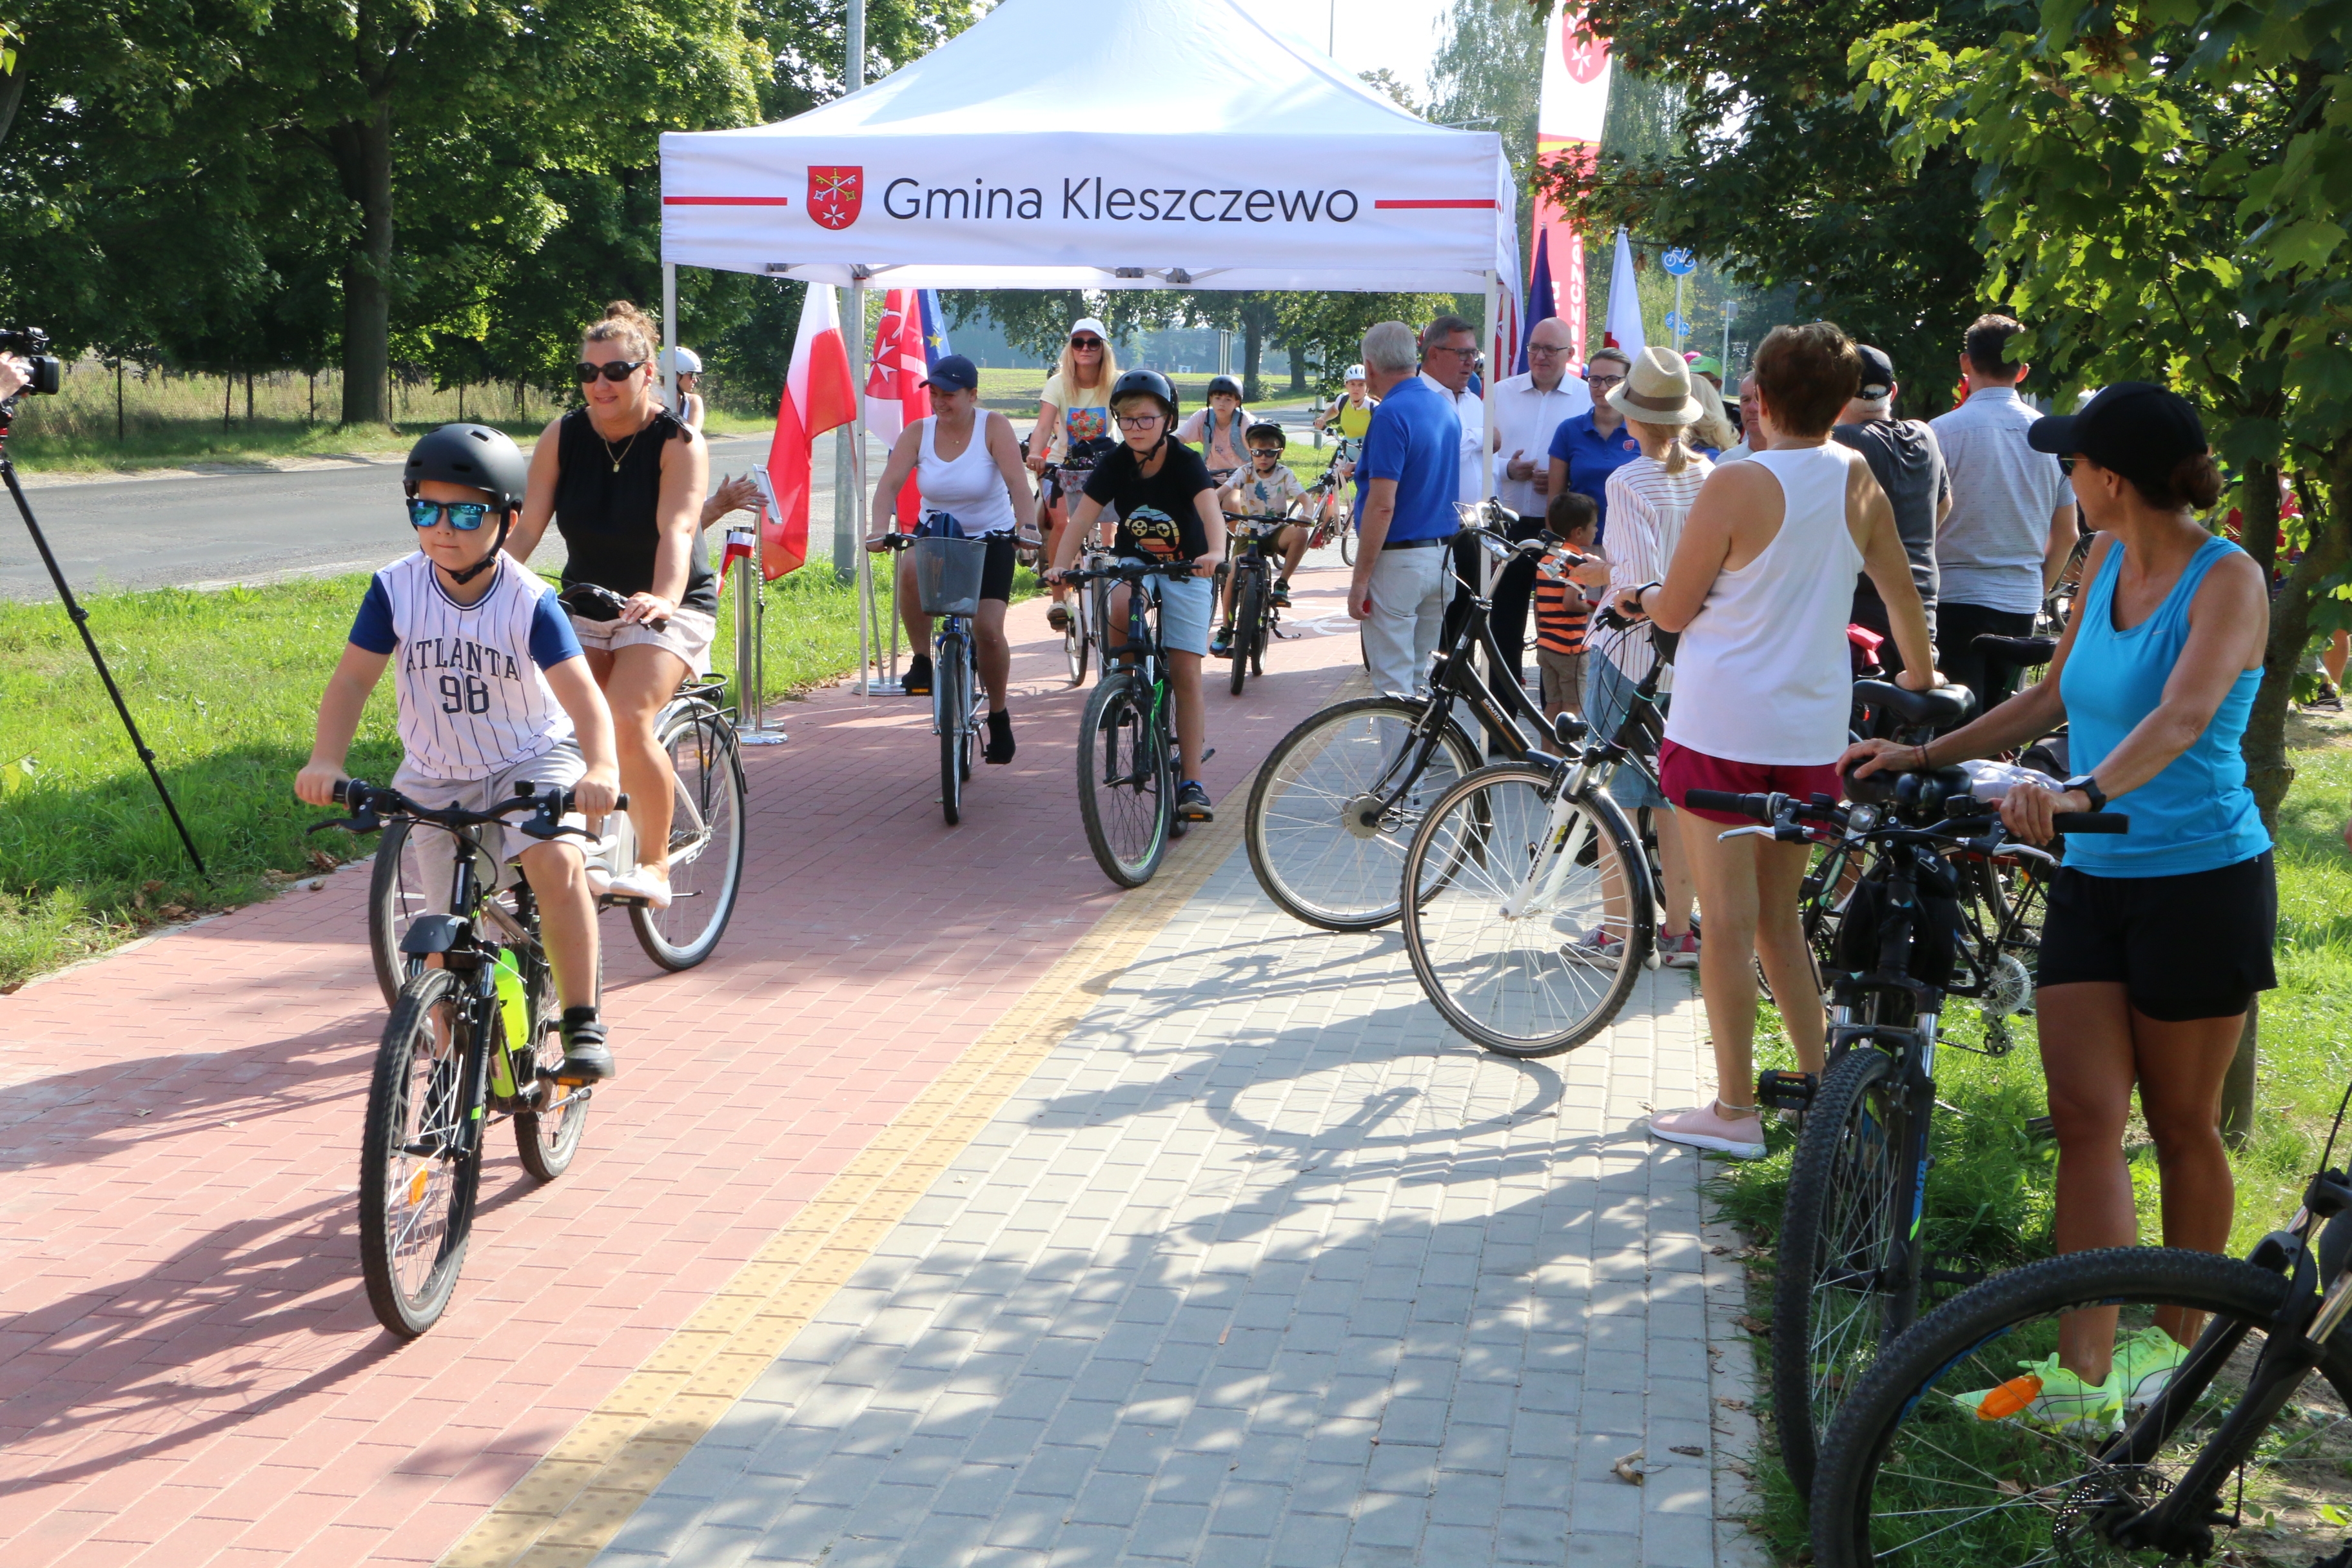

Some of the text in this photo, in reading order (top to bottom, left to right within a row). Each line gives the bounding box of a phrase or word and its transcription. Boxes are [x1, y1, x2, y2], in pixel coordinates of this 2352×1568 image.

[884, 177, 1358, 222] Gmina Kleszczewo
[406, 637, 520, 681] ATLANTA
[439, 674, 489, 714] 98
[1483, 698, 1504, 723] SPARTA
